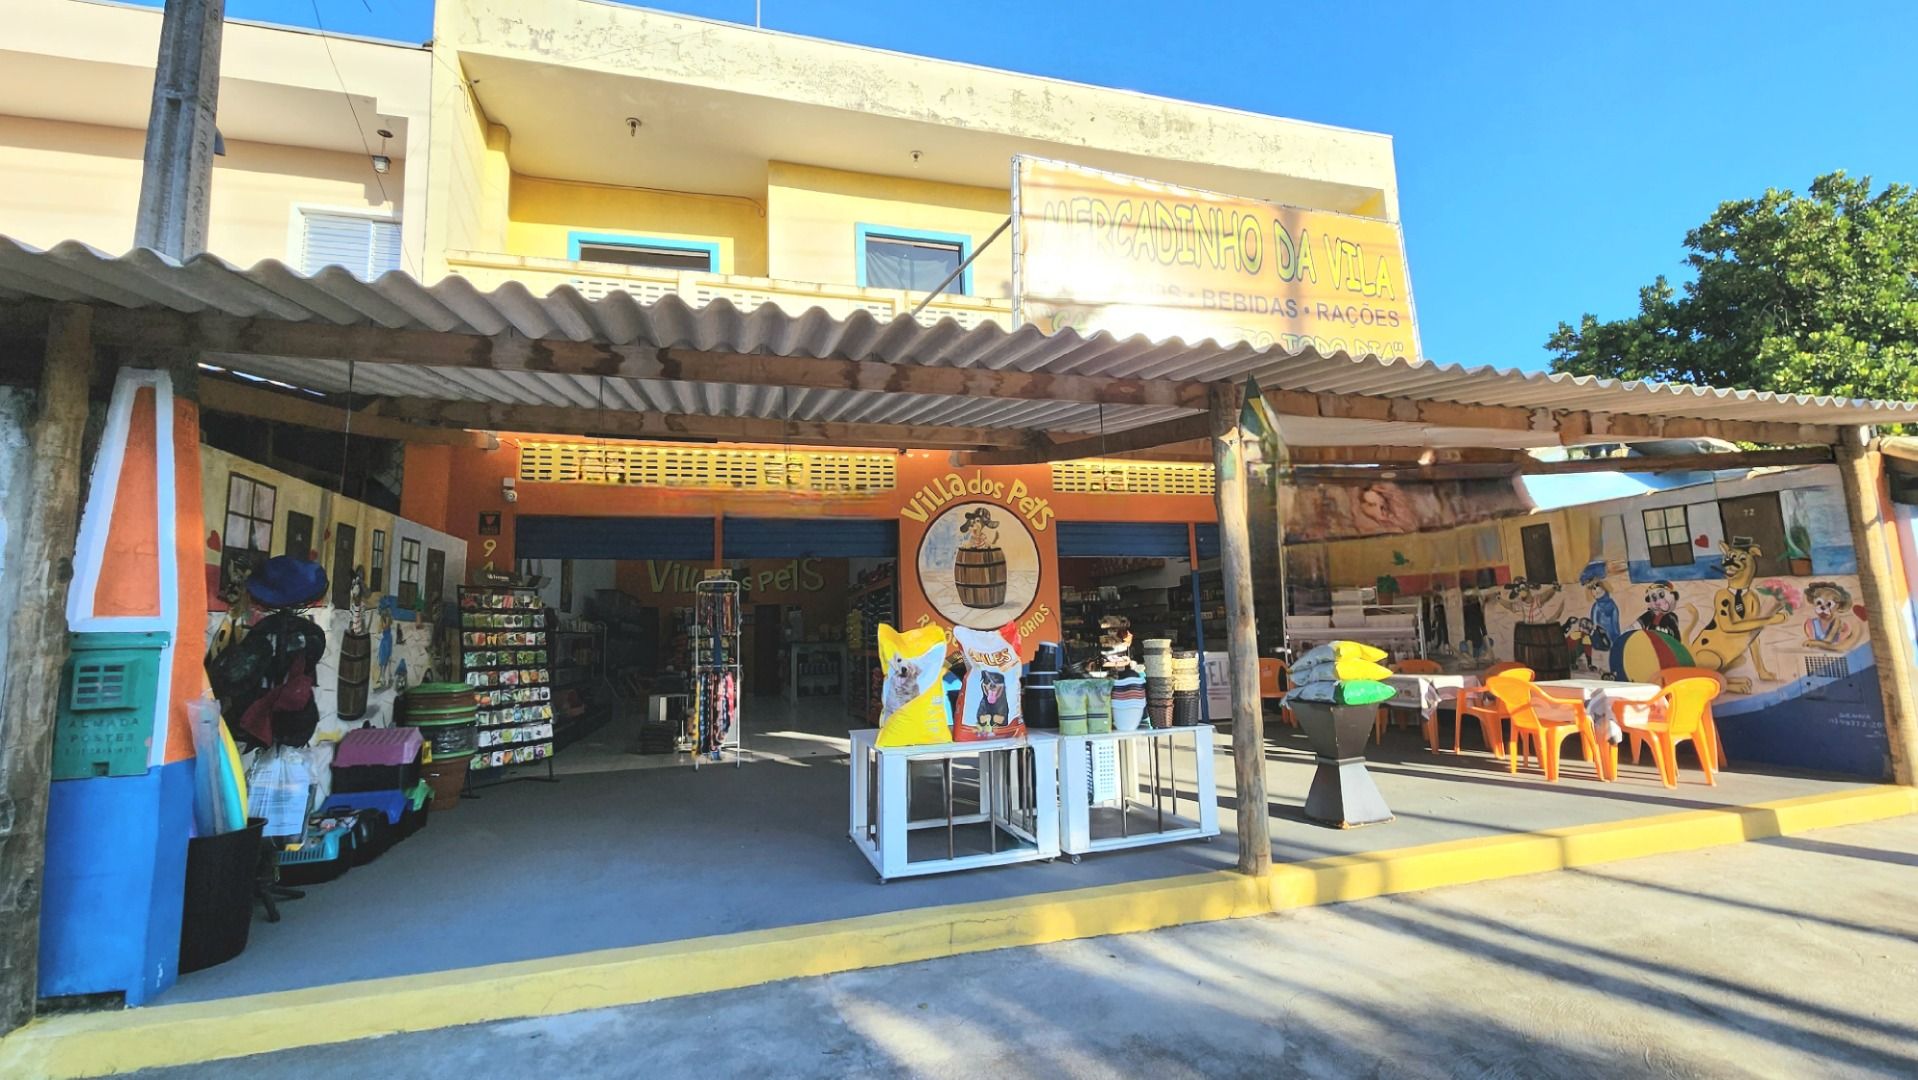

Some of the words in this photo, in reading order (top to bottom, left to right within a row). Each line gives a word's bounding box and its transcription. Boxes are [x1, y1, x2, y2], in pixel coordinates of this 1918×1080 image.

[1042, 196, 1264, 275] MERCADINHO
[1273, 219, 1317, 284] DA
[1323, 233, 1396, 301] VILA
[1202, 288, 1298, 318] BEBIDAS
[1316, 302, 1401, 329] RAÇÕES
[967, 469, 1005, 499] dos
[1019, 602, 1051, 638] ÓRIOS
